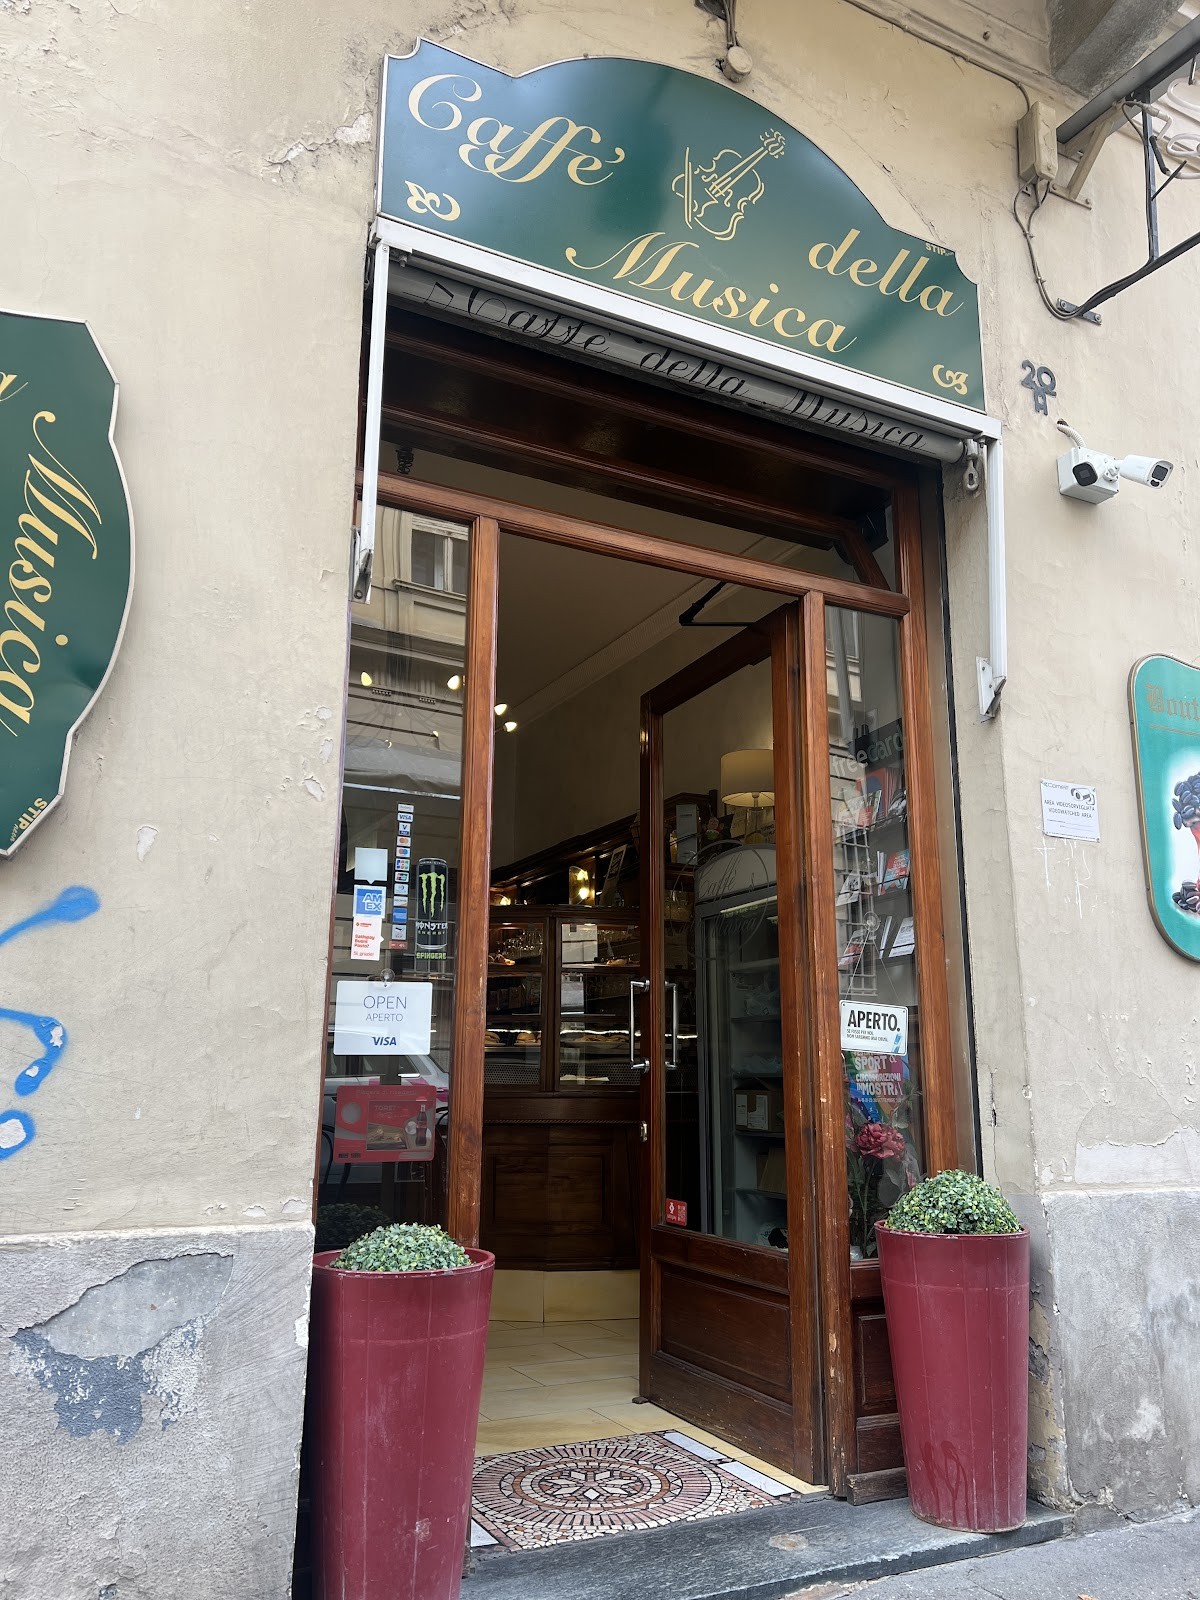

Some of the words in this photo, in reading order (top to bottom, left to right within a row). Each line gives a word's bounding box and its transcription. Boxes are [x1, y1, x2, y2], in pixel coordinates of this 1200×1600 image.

[925, 242, 946, 256] STIP
[807, 228, 964, 318] della
[565, 231, 858, 353] Musica
[1021, 359, 1057, 397] 20
[639, 348, 750, 396] della
[783, 388, 927, 450] Musica
[0, 410, 102, 738] Musica
[18, 797, 48, 830] STIP
[362, 893, 382, 903] AM
[365, 902, 382, 911] EX
[363, 995, 407, 1009] OPEN
[365, 1013, 404, 1022] APERTO
[847, 1009, 901, 1032] APERTO.
[372, 1036, 397, 1046] VISA
[854, 1055, 887, 1070] SPORT
